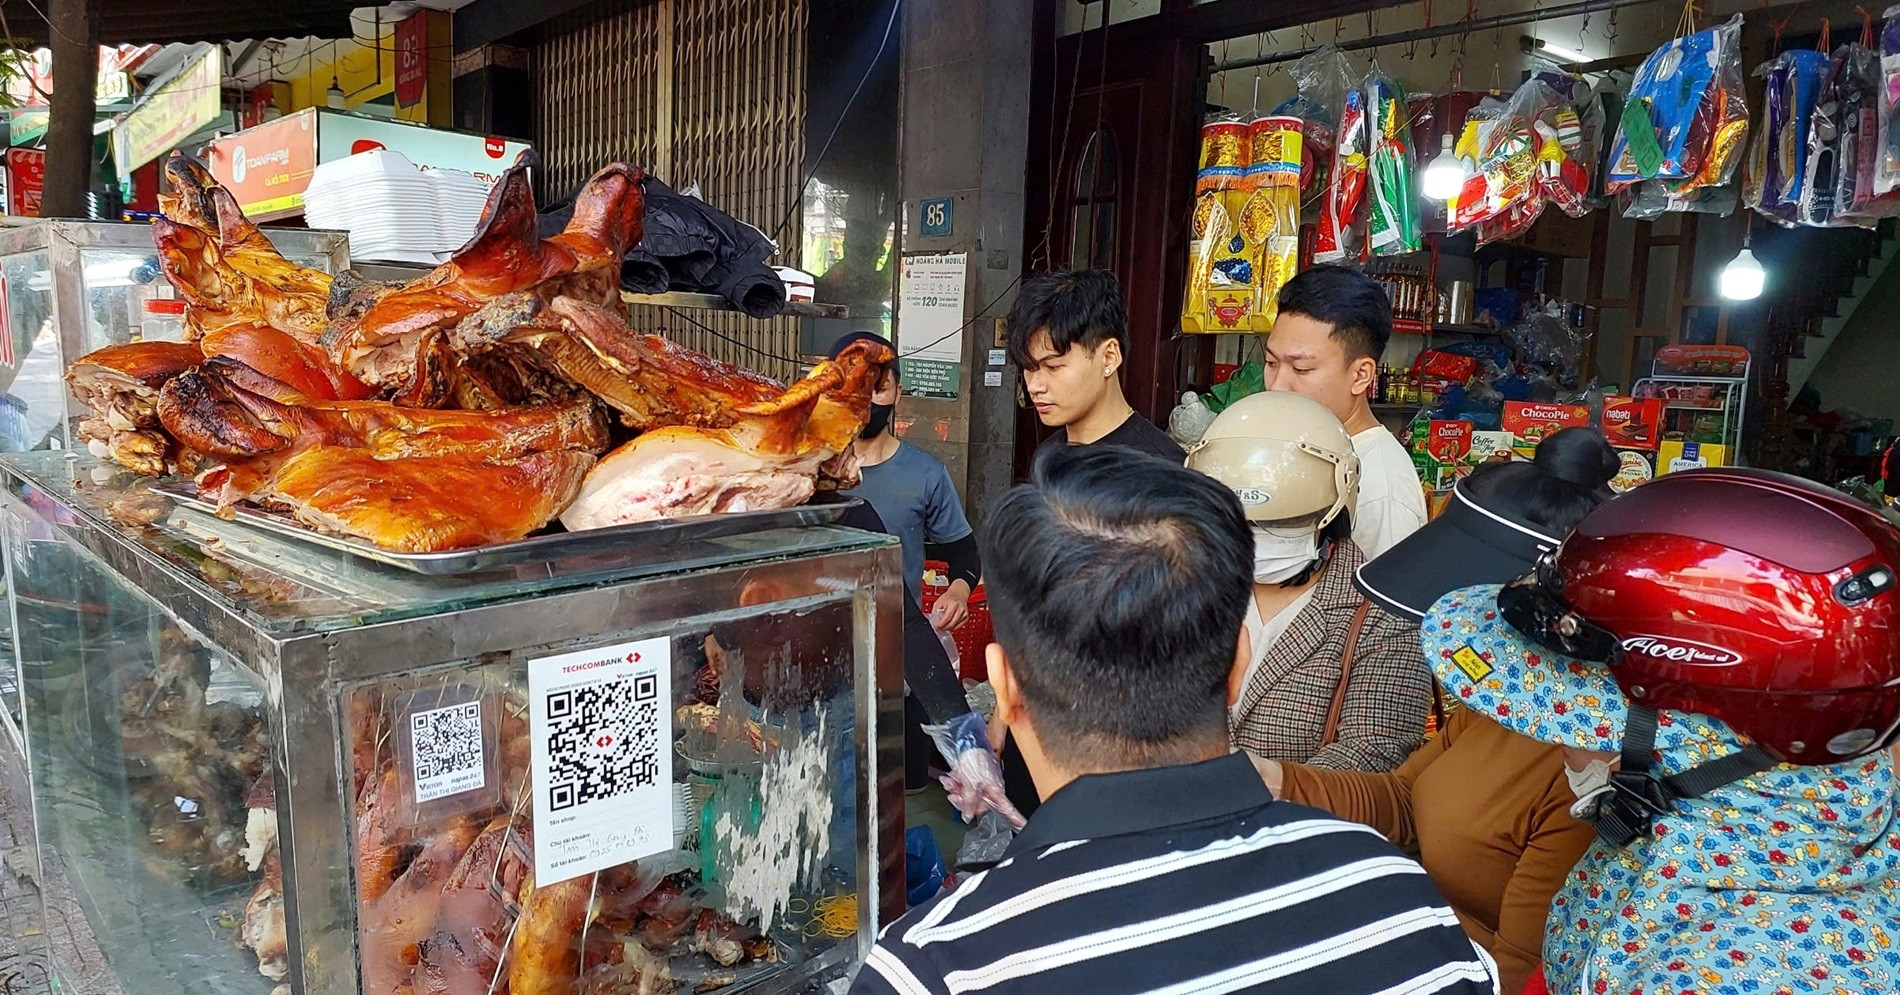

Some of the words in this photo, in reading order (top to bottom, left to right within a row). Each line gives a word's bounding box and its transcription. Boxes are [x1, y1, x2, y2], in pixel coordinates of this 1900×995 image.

[926, 203, 945, 226] 85
[945, 257, 966, 265] MOBILE
[921, 296, 938, 307] 120
[1521, 407, 1570, 420] ChocoPie
[1606, 409, 1630, 420] nabati
[1438, 427, 1463, 437] ChocoPie
[562, 657, 623, 674] TECHCOMBANK
